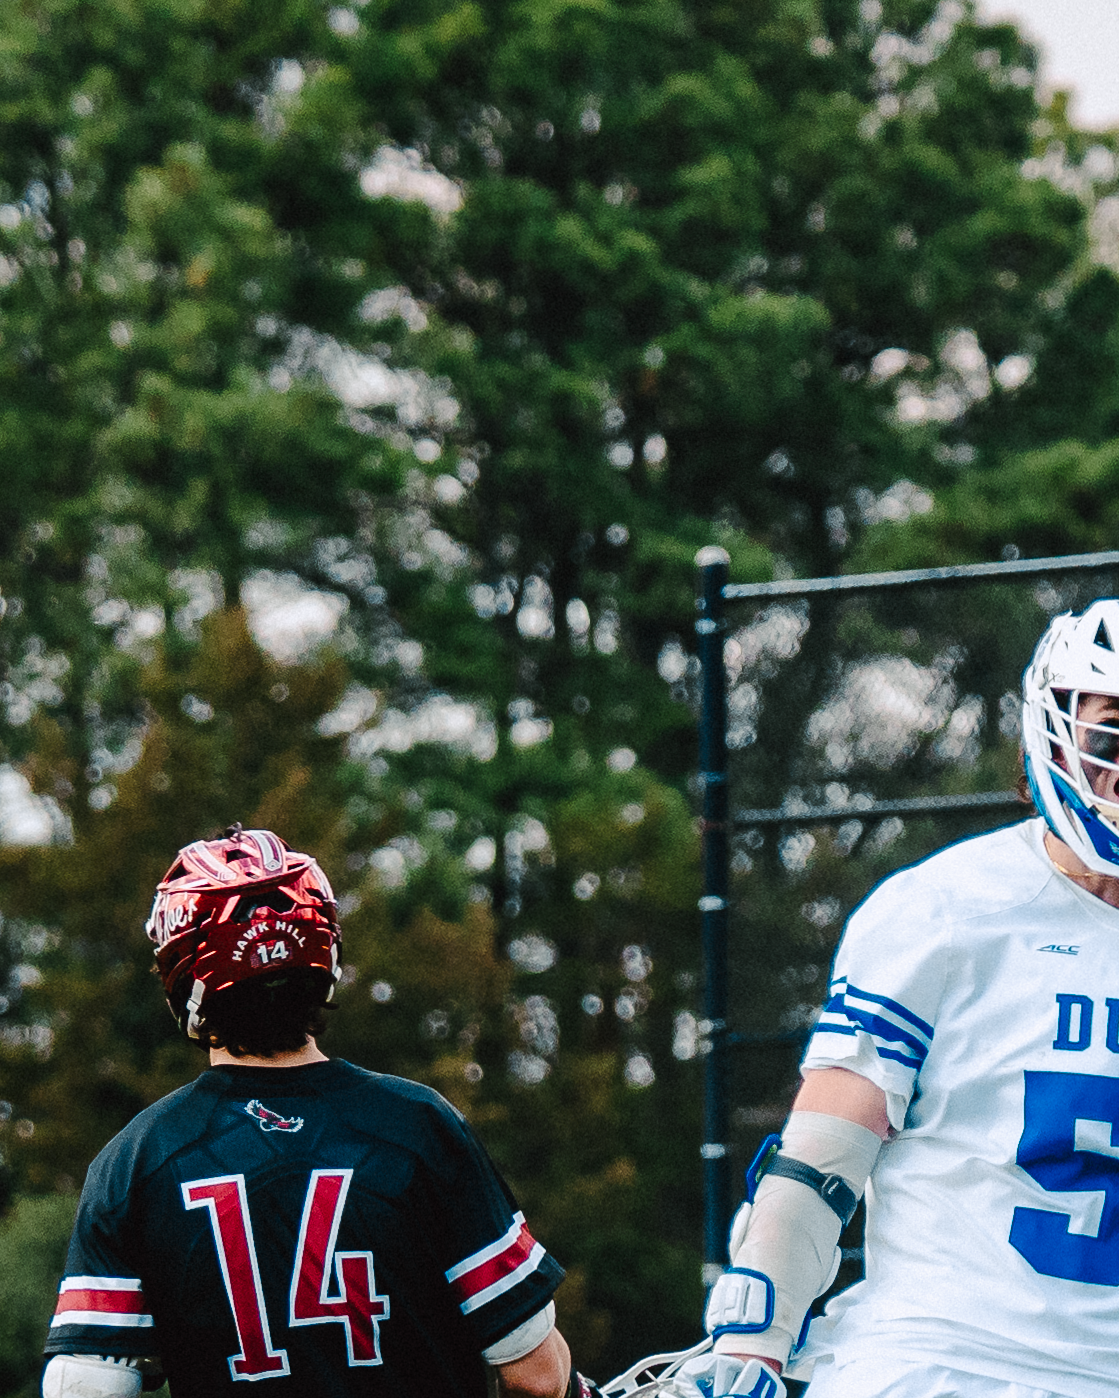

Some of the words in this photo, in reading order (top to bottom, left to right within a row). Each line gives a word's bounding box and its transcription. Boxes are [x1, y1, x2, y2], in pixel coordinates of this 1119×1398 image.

[232, 921, 269, 961] HAWK
[275, 920, 306, 948] HILL
[257, 940, 289, 964] 14
[1036, 944, 1081, 956] ACC
[180, 1168, 391, 1382] 14
